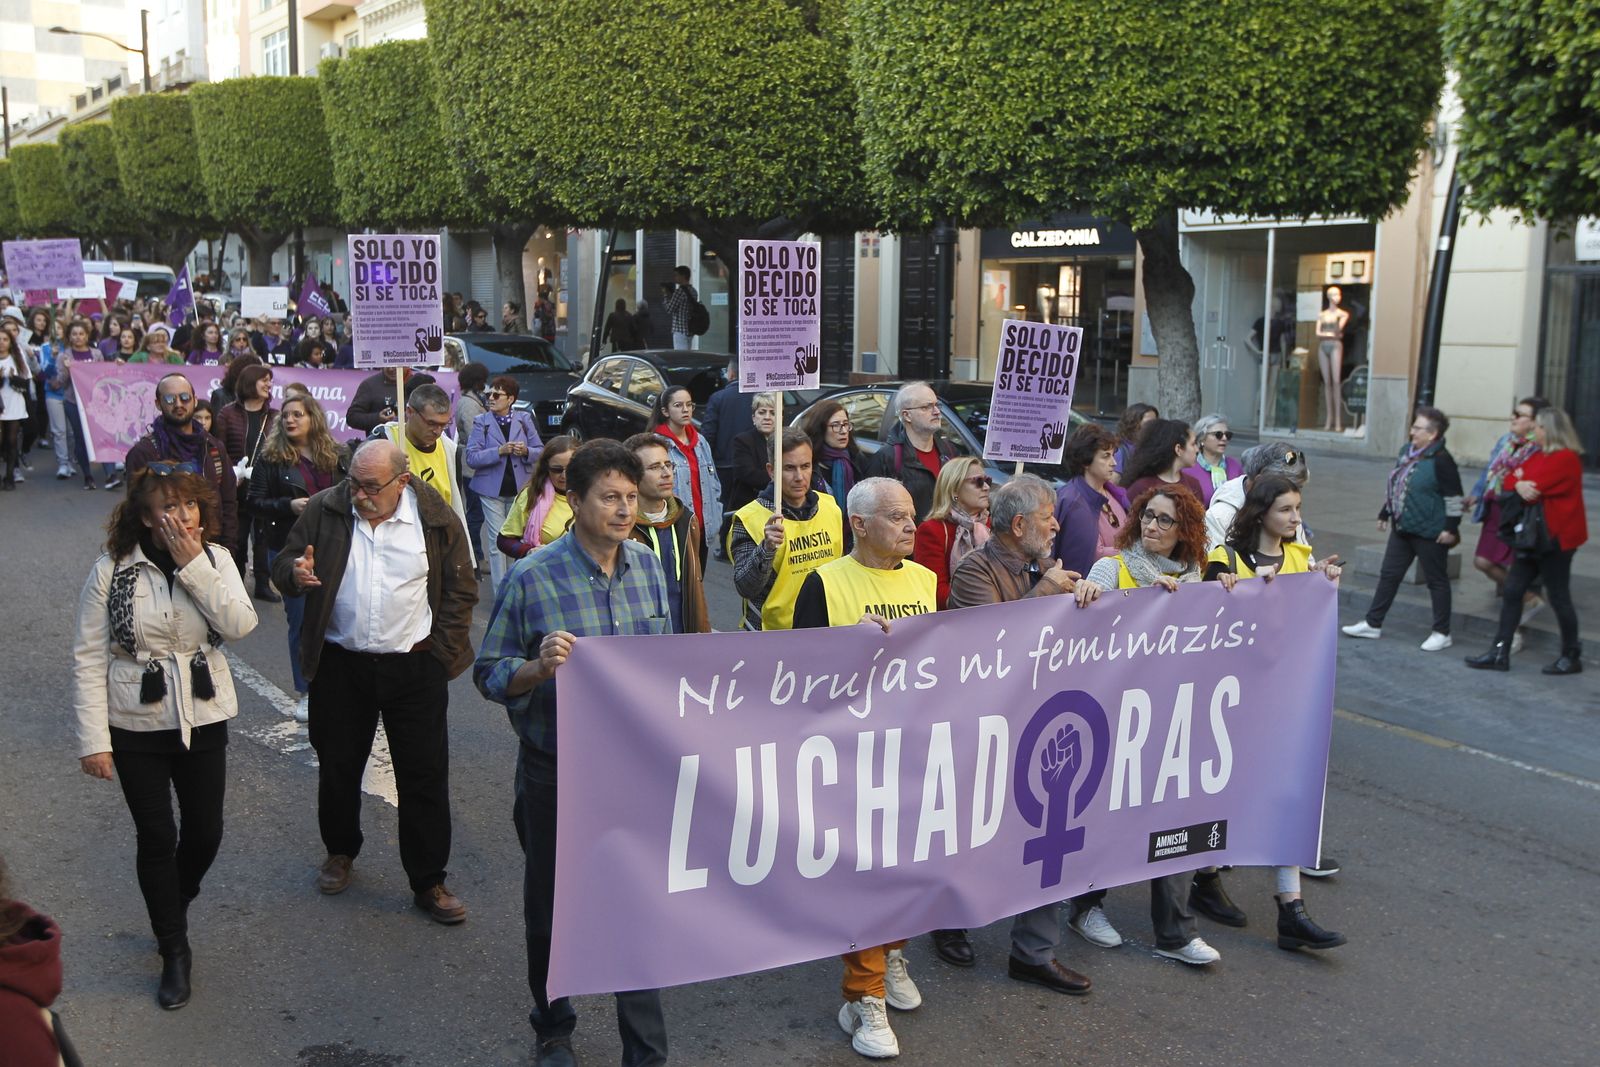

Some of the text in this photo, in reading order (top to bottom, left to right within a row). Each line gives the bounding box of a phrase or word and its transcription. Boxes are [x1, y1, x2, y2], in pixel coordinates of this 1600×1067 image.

[1011, 228, 1100, 248] CALZEDONIA
[354, 240, 436, 260] SOLO YO
[744, 245, 817, 270] SOLO YO
[355, 261, 437, 285] DECIDO
[356, 286, 438, 301] SI SE TOCA
[744, 271, 817, 298] DECIDO
[744, 298, 817, 316] SI SE TOCA
[1006, 325, 1078, 353] SOLO YO
[1001, 348, 1074, 378] DECIDO
[999, 374, 1069, 396] SI SE TOCA
[790, 529, 832, 552] AMNISTÍA
[788, 547, 834, 566] INTERNACIONAL
[770, 647, 939, 719] brujas
[1156, 830, 1188, 848] AMNISTÍA
[1155, 844, 1188, 857] INTERNACIONAL
